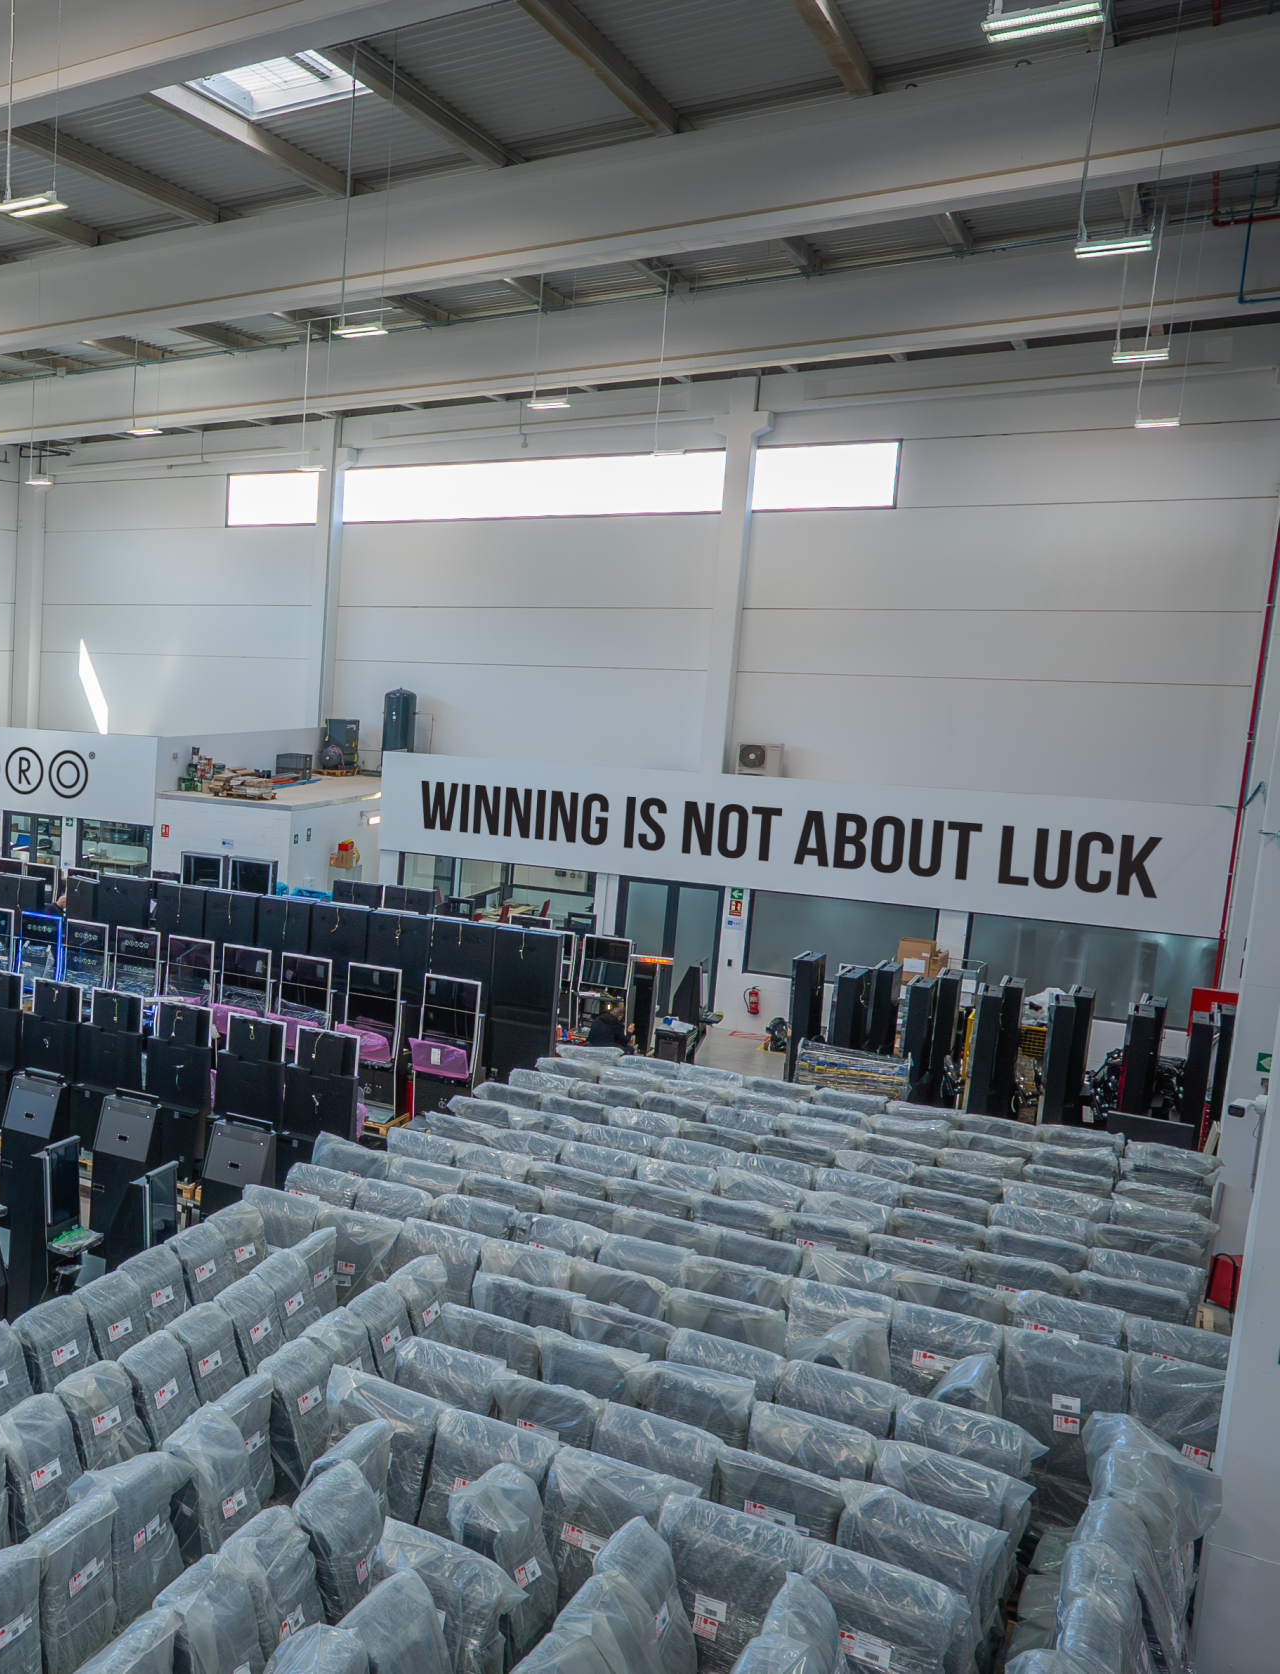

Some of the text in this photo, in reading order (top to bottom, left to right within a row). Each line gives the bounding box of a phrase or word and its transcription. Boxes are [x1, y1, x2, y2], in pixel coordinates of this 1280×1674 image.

[421, 781, 1163, 899] WINNING IS NOT ABOUT LUCK
